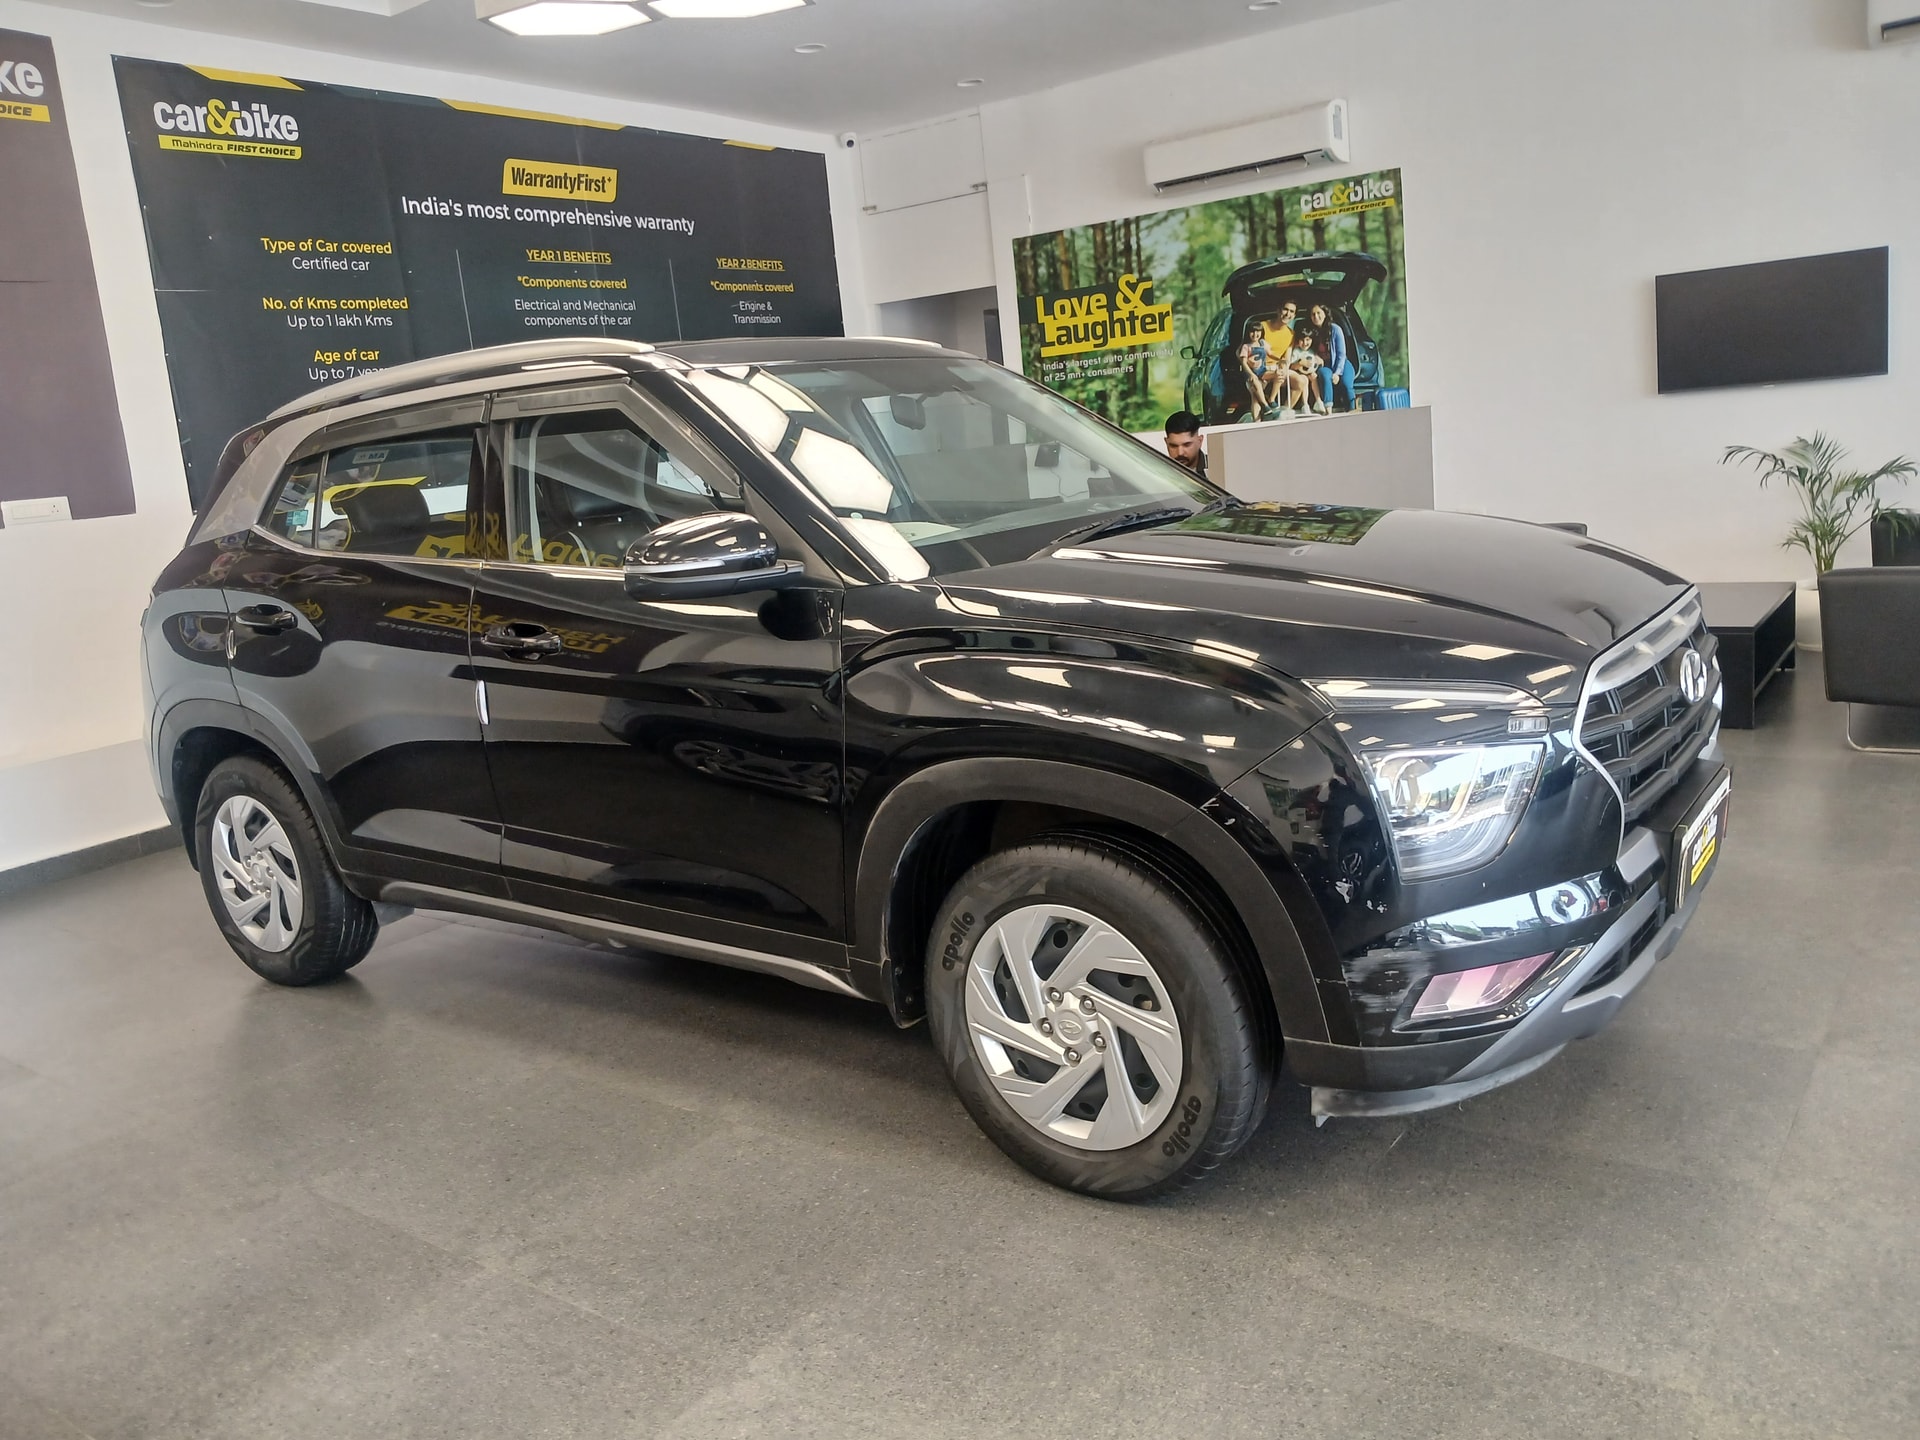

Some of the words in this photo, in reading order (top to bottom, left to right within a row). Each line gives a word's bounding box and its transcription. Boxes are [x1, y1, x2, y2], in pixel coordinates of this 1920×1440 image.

[153, 98, 299, 141] car&bike
[172, 139, 224, 151] Mahindra
[227, 143, 257, 153] FIRST
[259, 146, 296, 156] CHOICE
[1300, 178, 1394, 209] car&bike
[1338, 205, 1359, 214] FIRST
[1360, 201, 1387, 210] CHOICE
[401, 196, 463, 217] India's
[467, 203, 511, 220] most
[514, 207, 632, 228] comprehensive
[634, 216, 695, 236] warranty
[260, 237, 296, 253] Type
[299, 238, 313, 252] of
[315, 239, 338, 252] Car
[341, 241, 392, 254] covered
[292, 256, 348, 270] Certified
[351, 260, 370, 271] car
[526, 249, 555, 261] YEAR
[556, 250, 561, 261] 1
[563, 250, 612, 263] BENEFITS
[716, 257, 739, 268] YEAR
[740, 259, 747, 268] 2
[747, 259, 783, 270] BENEFITS
[589, 278, 627, 289] covered
[764, 282, 794, 293] covered
[262, 297, 287, 310] No.
[289, 296, 304, 309] of
[306, 297, 337, 310] Kms
[340, 297, 409, 311] completed
[514, 299, 560, 311] Electrical
[562, 300, 581, 311] and
[583, 300, 636, 311] Mechanical
[1036, 292, 1108, 323] Love
[1115, 273, 1153, 309] &
[739, 300, 766, 313] Engine
[766, 301, 773, 311] &
[287, 315, 307, 330] Up
[310, 315, 324, 327] to
[325, 314, 332, 327] 1
[334, 314, 362, 327] lakh
[364, 314, 393, 327] Kms
[524, 316, 588, 328] components
[588, 314, 599, 326] of
[600, 315, 616, 326] the
[617, 316, 632, 326] car
[732, 314, 781, 324] Transmission
[1037, 310, 1170, 348] Laughter
[314, 350, 341, 364] Age
[344, 348, 357, 361] of
[360, 350, 380, 361] car
[1043, 359, 1070, 371] India's
[1071, 357, 1101, 369] largest
[1103, 355, 1123, 364] auto
[308, 367, 329, 382] Up
[331, 368, 345, 379] to
[346, 366, 355, 378] 7
[1043, 374, 1053, 382] of
[1054, 371, 1066, 381] 25
[1087, 365, 1134, 378] consumers
[942, 911, 975, 971] apollo
[1161, 1095, 1202, 1157] apollo
